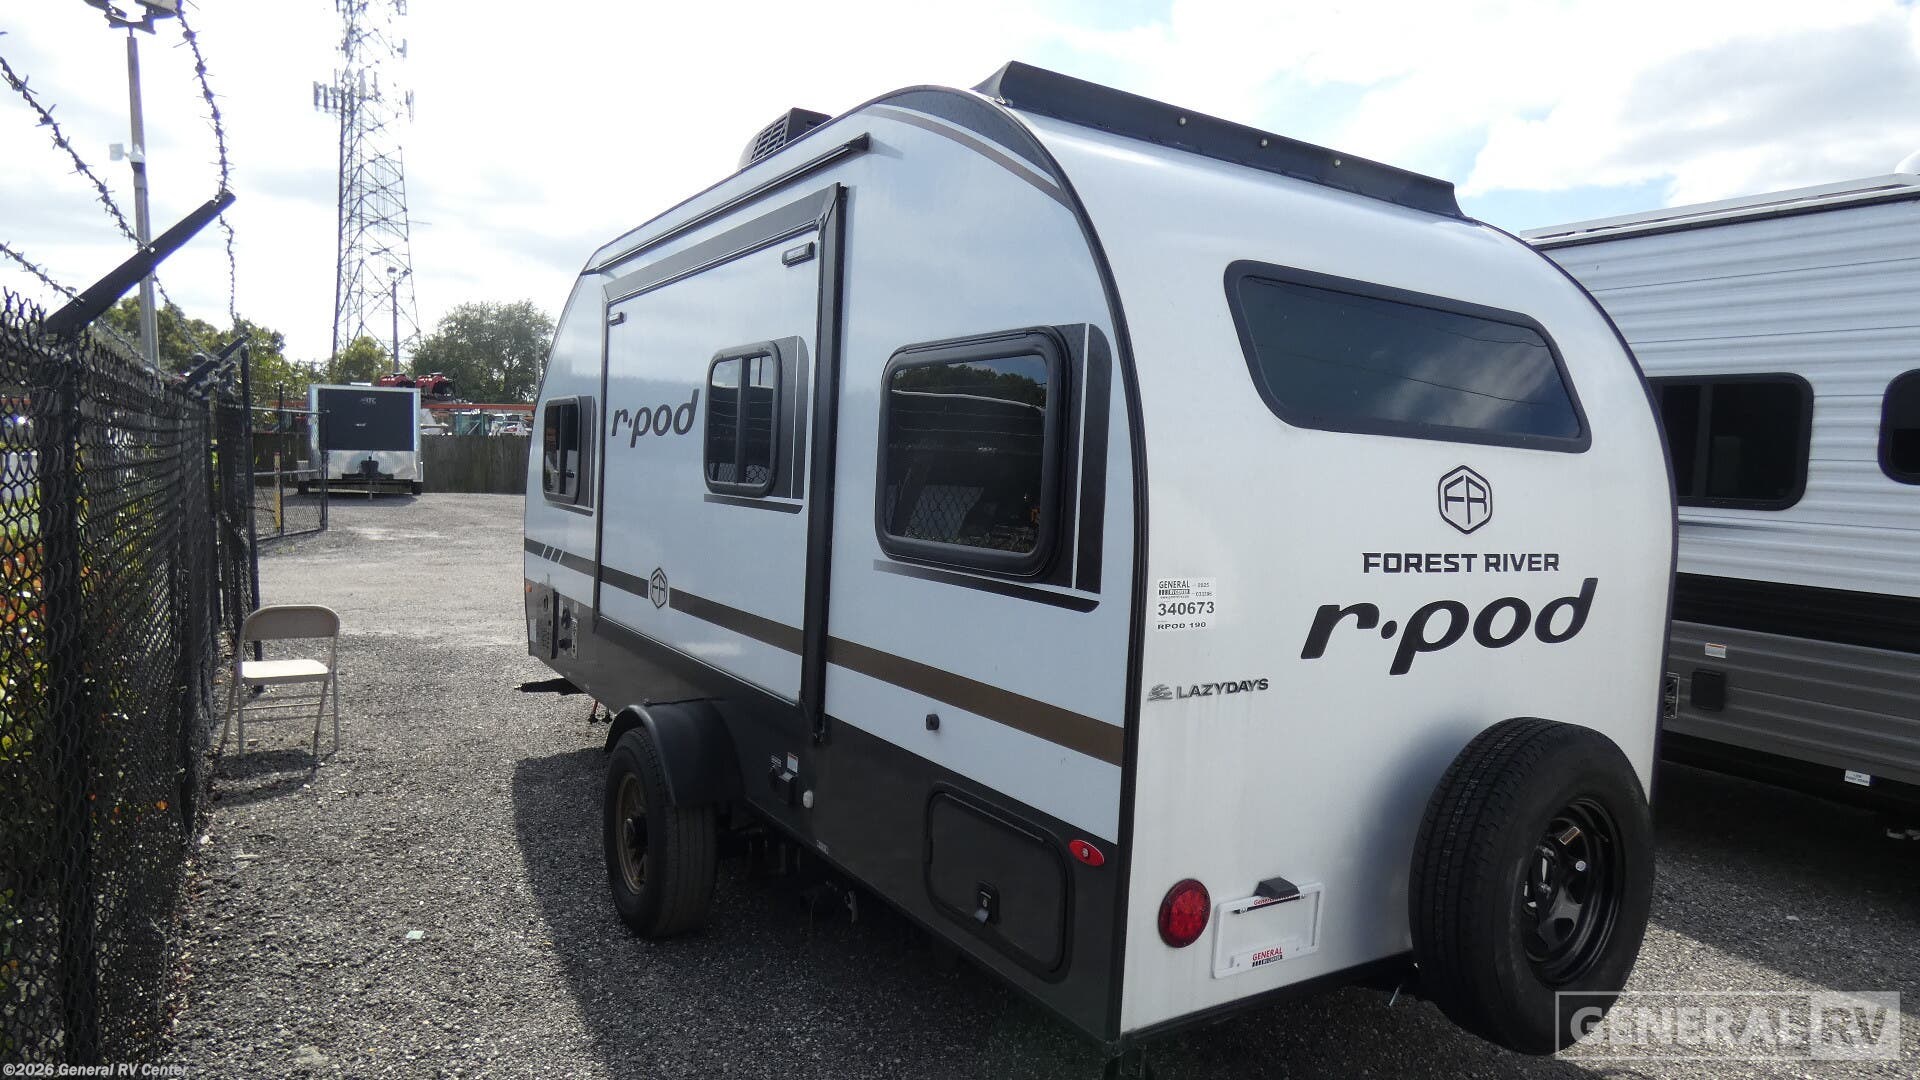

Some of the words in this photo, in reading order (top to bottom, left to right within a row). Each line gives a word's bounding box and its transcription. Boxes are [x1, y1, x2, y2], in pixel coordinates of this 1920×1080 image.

[1362, 552, 1477, 573] FOREST
[1484, 553, 1560, 572] RIVER
[1158, 580, 1190, 589] GENERAL
[1157, 601, 1215, 616] 340673
[1176, 678, 1269, 700] LAZYDAYS
[1252, 947, 1283, 961] GENERAL
